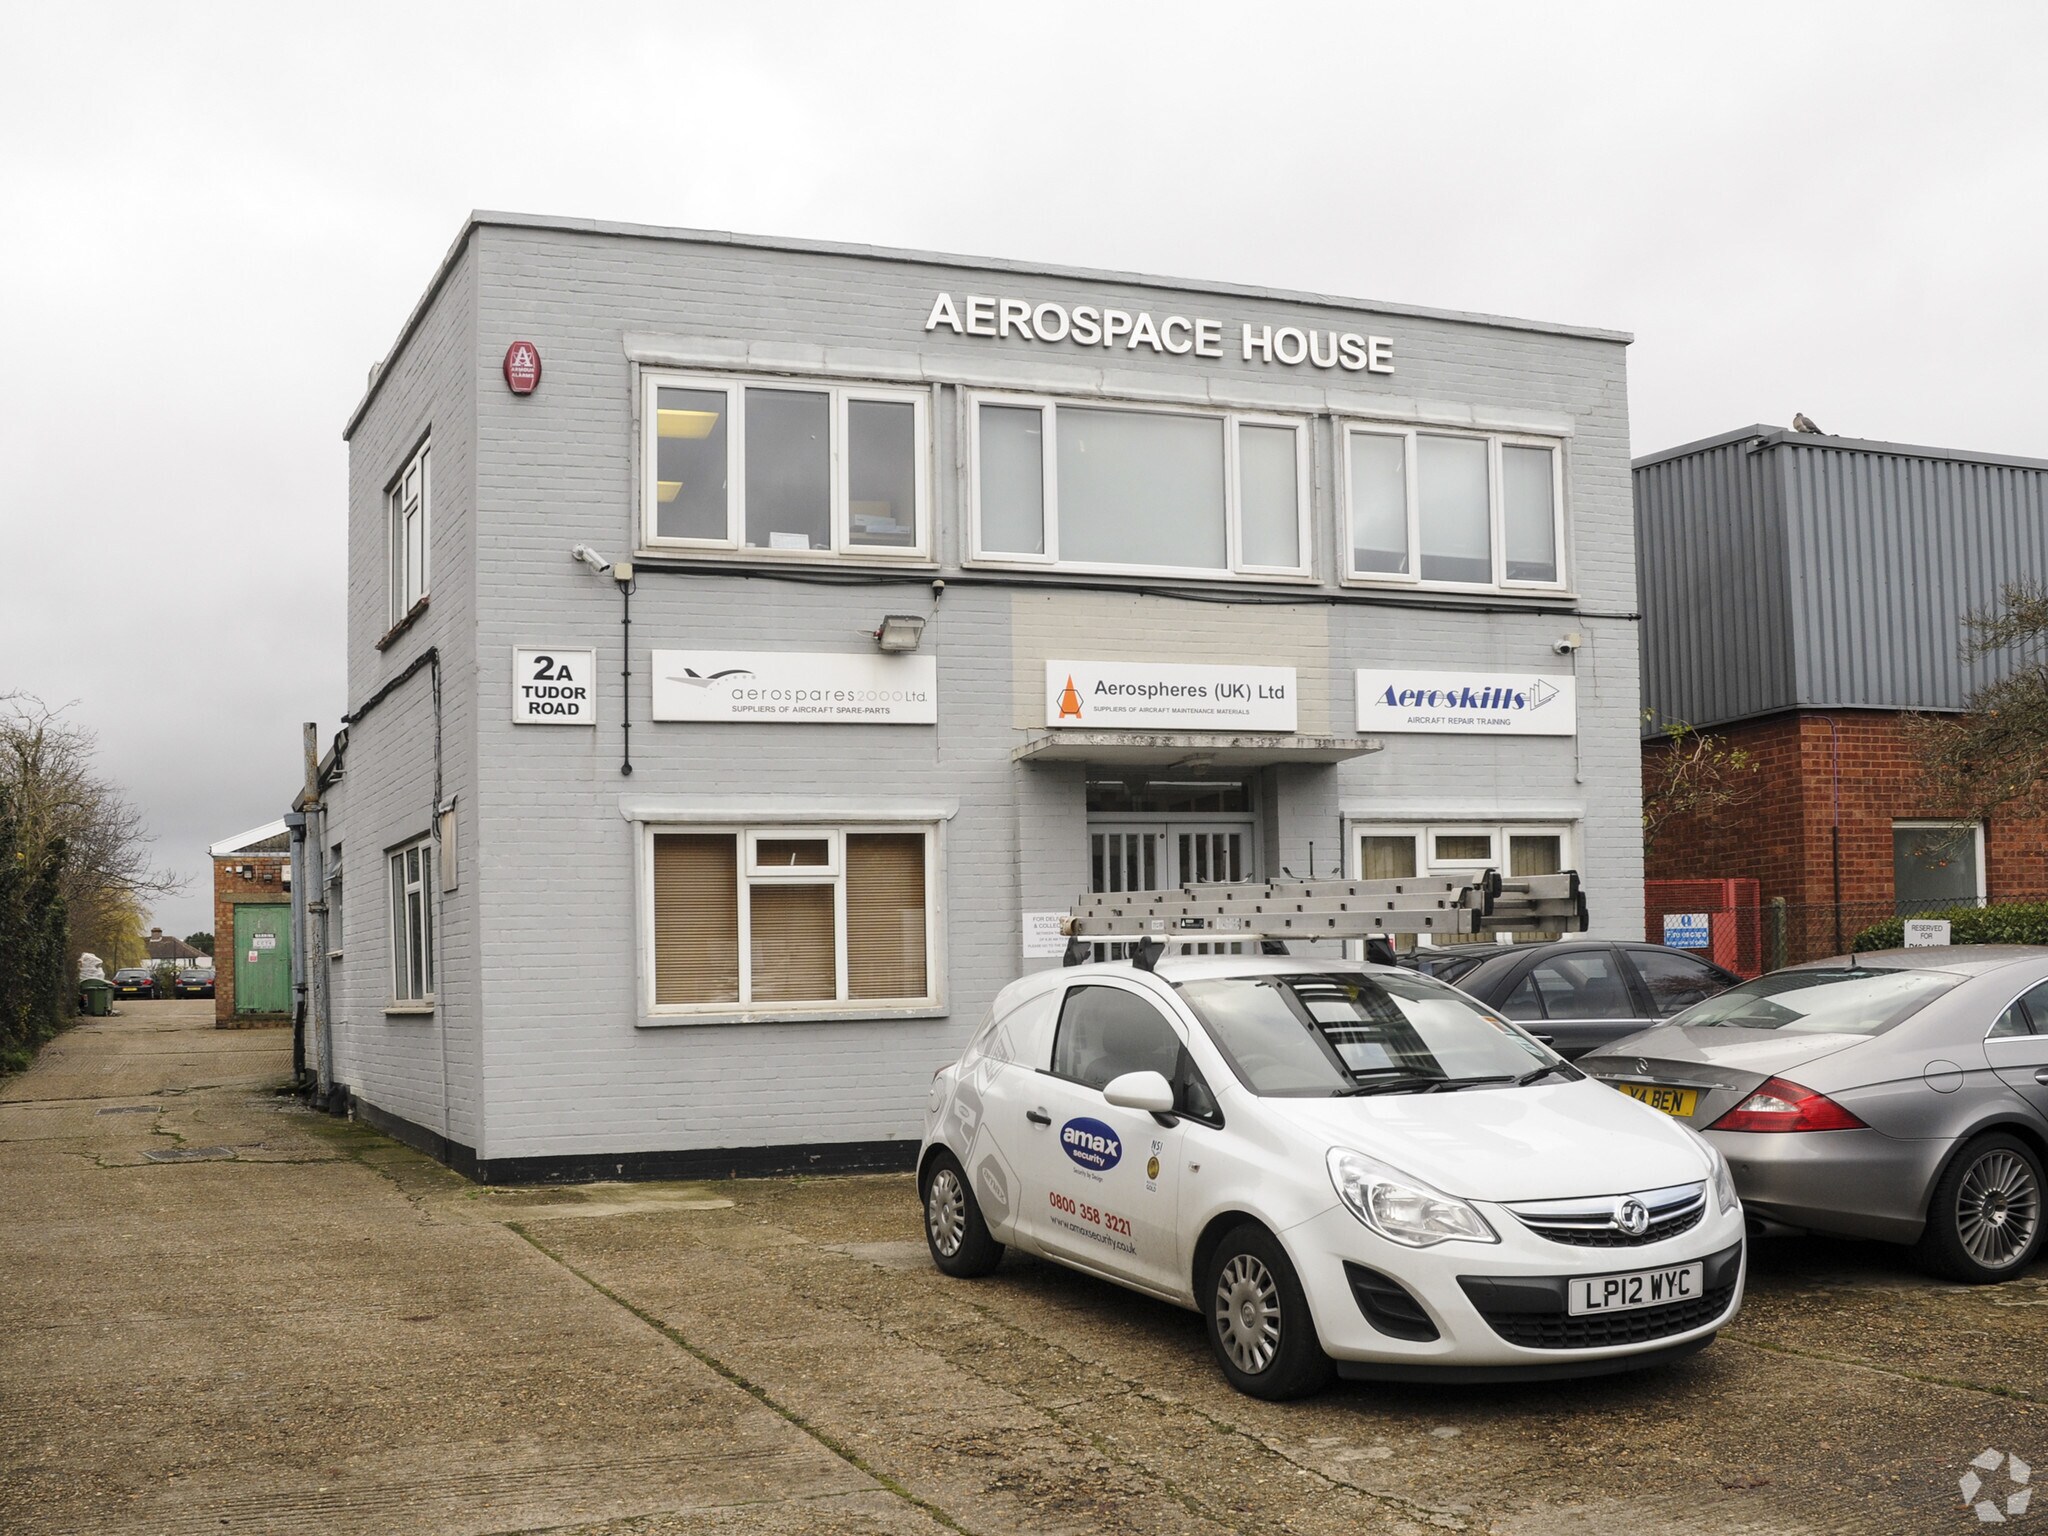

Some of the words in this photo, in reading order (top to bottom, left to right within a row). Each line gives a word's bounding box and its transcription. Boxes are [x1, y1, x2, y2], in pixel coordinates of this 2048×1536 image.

[925, 292, 1224, 357] AEROSPACE
[1242, 323, 1395, 374] HOUSE
[532, 655, 574, 682] 2A
[521, 685, 587, 700] TUDOR
[1094, 680, 1208, 700] Aerospheres
[1214, 682, 1252, 702] (UK)
[1258, 684, 1285, 700] Ltd
[1375, 684, 1527, 710] Aeroskills
[528, 701, 580, 716] ROAD
[732, 705, 776, 713] SUPPLIERS
[792, 706, 834, 714] AIRCRAFT
[836, 707, 891, 715] SPARE-PARTS
[1407, 717, 1446, 725] AIRCRAFT
[1448, 717, 1475, 725] REPAIR
[1477, 718, 1511, 726] TRAINING
[1911, 924, 1944, 932] RESERVED
[1651, 1089, 1684, 1112] BEN
[1063, 1127, 1119, 1157] amax
[1073, 1149, 1105, 1167] security
[1049, 1191, 1076, 1215] 0800
[1080, 1203, 1101, 1225] 358
[1104, 1212, 1132, 1237] 3221
[1050, 1215, 1137, 1256] www.amaxsecurity.co.uk
[1586, 1277, 1643, 1309] LP12
[1650, 1269, 1691, 1300] WYC
